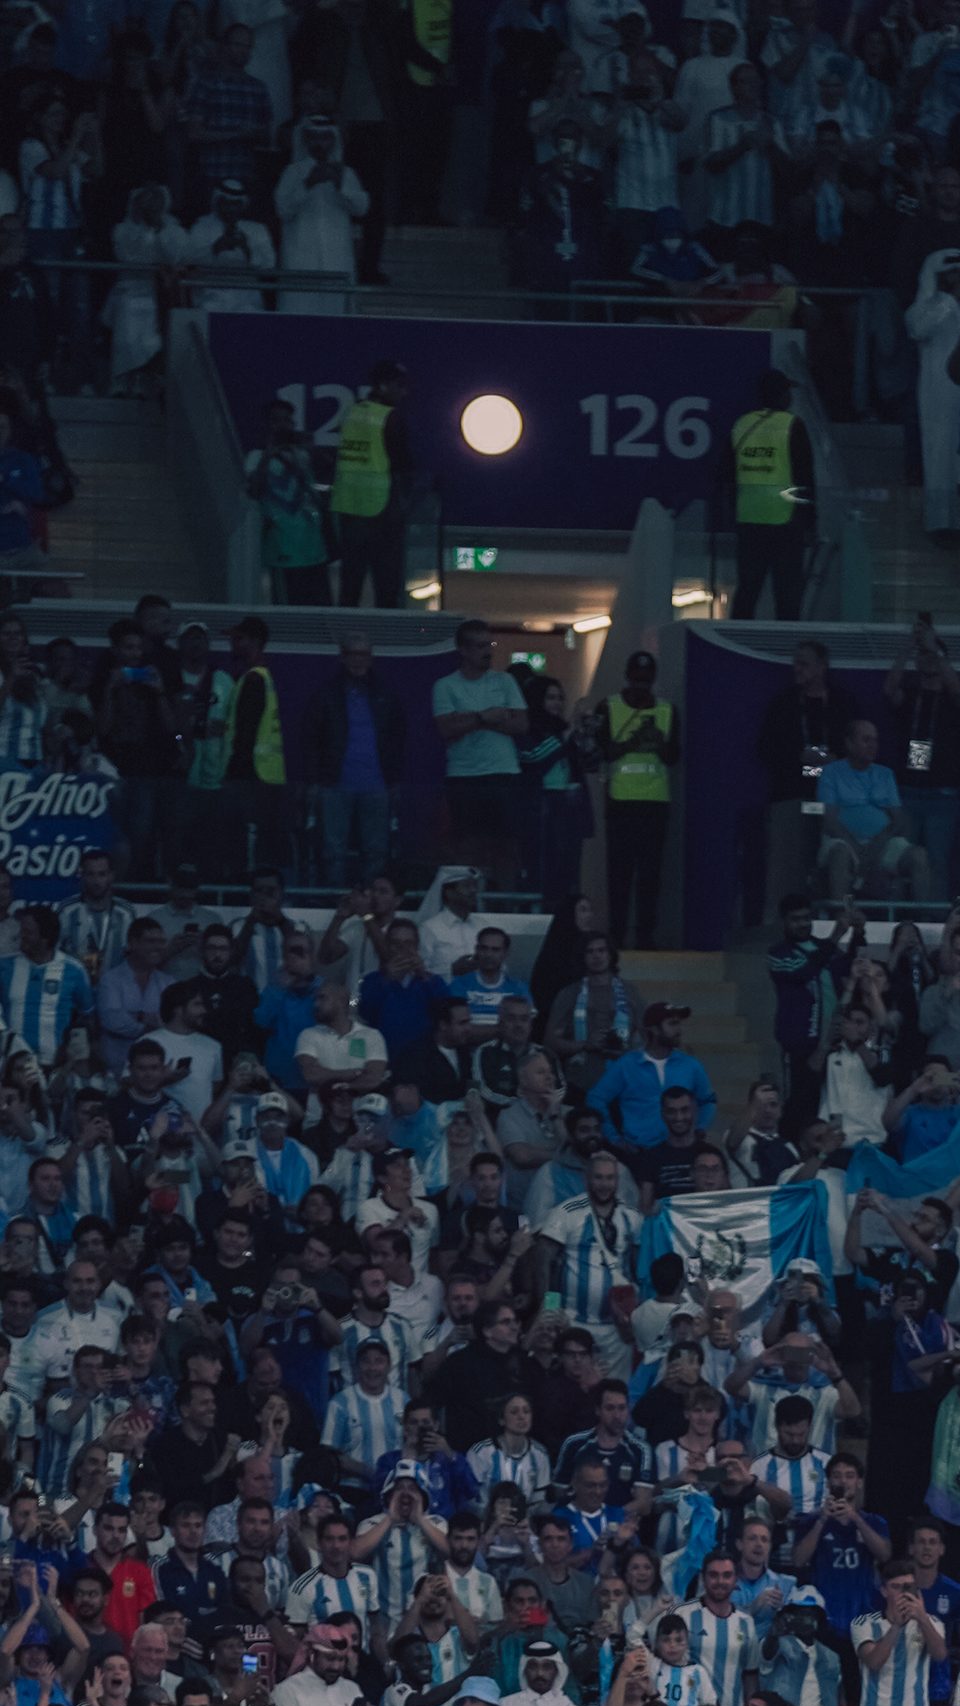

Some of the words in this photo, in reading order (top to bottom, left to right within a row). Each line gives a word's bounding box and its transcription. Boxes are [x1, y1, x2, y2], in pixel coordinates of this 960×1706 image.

[276, 383, 373, 447] 12
[579, 394, 712, 459] 126
[0, 822, 102, 877] asió
[832, 1546, 860, 1569] 20
[664, 1683, 682, 1701] 10
